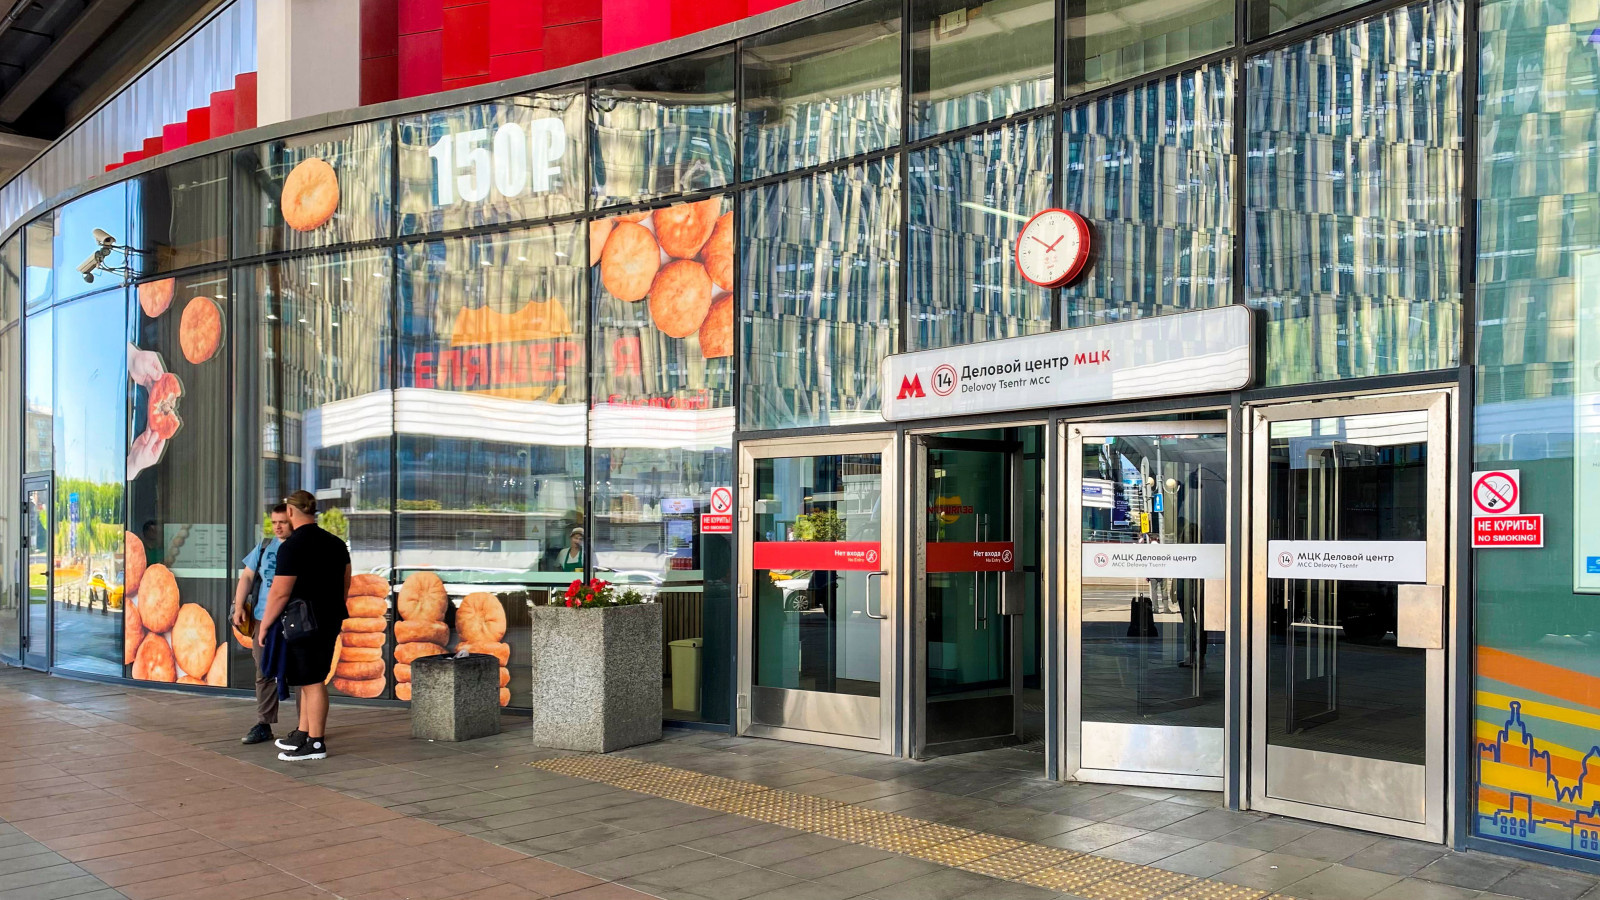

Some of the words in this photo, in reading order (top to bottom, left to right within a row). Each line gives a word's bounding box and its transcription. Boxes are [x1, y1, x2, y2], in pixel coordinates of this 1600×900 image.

[961, 359, 1021, 381] Деловой
[1025, 355, 1069, 373] центр
[1073, 349, 1111, 366] МЦК
[937, 373, 952, 388] 14
[961, 381, 997, 394] Delovoy
[999, 378, 1027, 390] Tsentr
[1029, 375, 1051, 386] MCC
[1478, 520, 1492, 531] НЕ
[1494, 519, 1537, 531] КУРИТЬ!
[1492, 534, 1537, 542] SMOKING!
[1136, 553, 1172, 561] Деловой
[1297, 553, 1321, 561] МЦК
[1323, 552, 1363, 561] Деловой
[1365, 554, 1395, 563] центр
